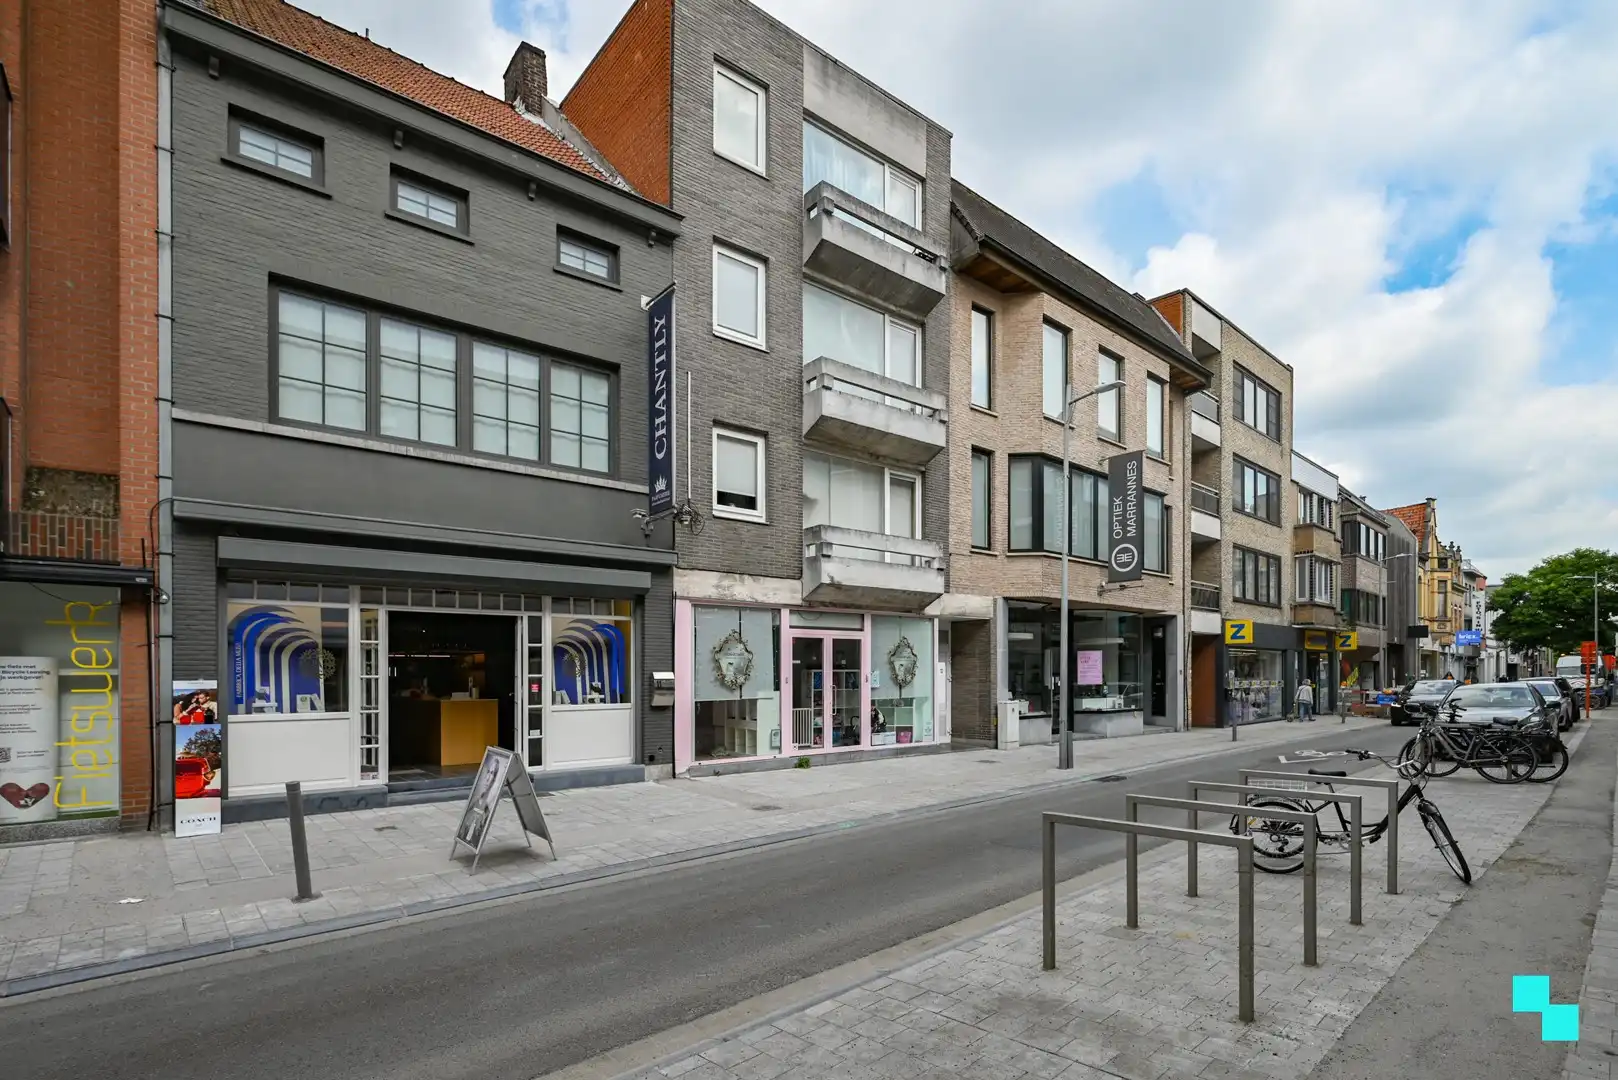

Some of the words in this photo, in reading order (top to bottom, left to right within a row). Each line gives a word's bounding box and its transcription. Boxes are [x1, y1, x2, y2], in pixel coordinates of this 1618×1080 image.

[654, 314, 667, 460] CHANTLY
[1113, 495, 1123, 539] OPTIEK
[1126, 460, 1137, 537] MARRANNES
[1230, 623, 1246, 640] Z
[1338, 634, 1352, 647] Z
[45, 600, 113, 808] Fietswerk
[180, 816, 217, 824] COACH
